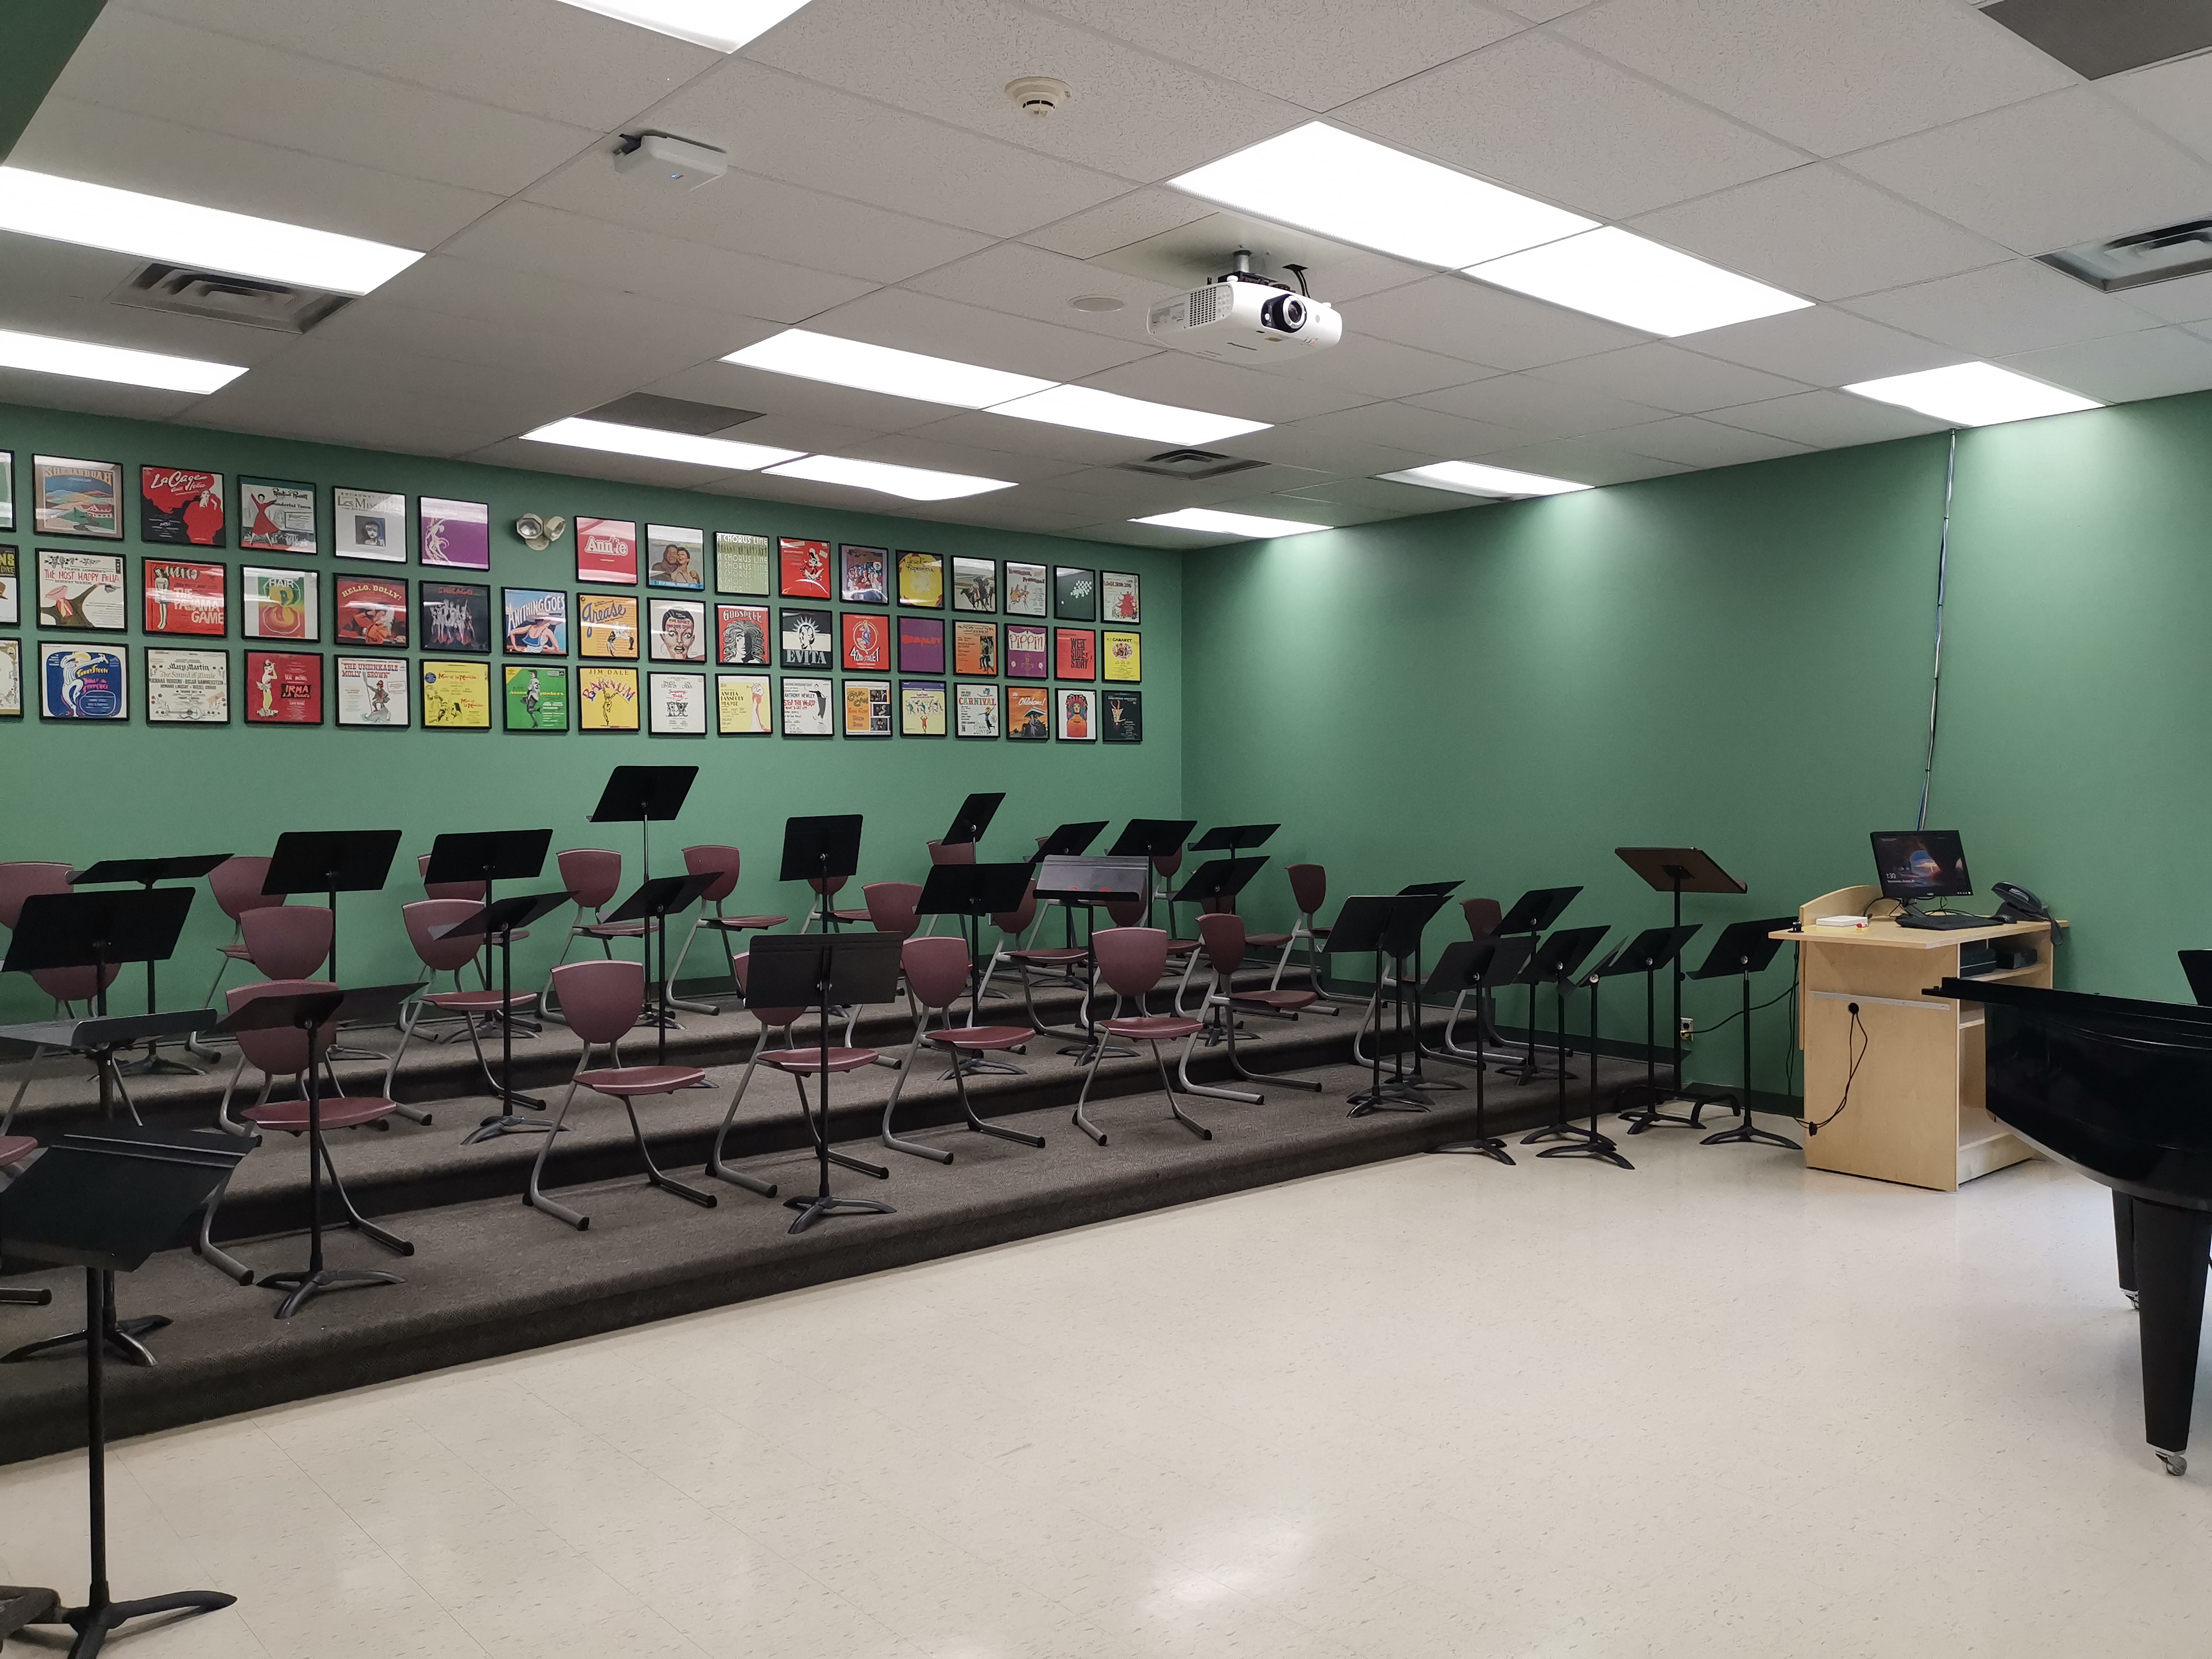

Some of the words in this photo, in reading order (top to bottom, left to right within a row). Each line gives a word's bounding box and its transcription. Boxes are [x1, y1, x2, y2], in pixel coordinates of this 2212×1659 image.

[168, 470, 208, 491] Cage
[724, 535, 751, 544] CHORUS
[585, 536, 628, 556] Annie
[724, 554, 751, 563] CHORUS
[724, 561, 751, 570] CHORUS
[44, 569, 56, 579] THE
[59, 571, 75, 580] MOST
[78, 573, 99, 582] HAPPY
[101, 574, 120, 583] FELLA
[269, 578, 294, 589] HAIR
[372, 584, 402, 601] DOLLY!
[544, 594, 565, 613] GOES
[191, 611, 224, 625] GAME
[723, 609, 763, 623] GODSPELL
[786, 649, 827, 664] EVITA
[168, 663, 186, 671] Mary
[358, 663, 398, 672] UNSINKABLE
[285, 685, 309, 693] IRMA
[959, 697, 996, 706] CARNIVAL
